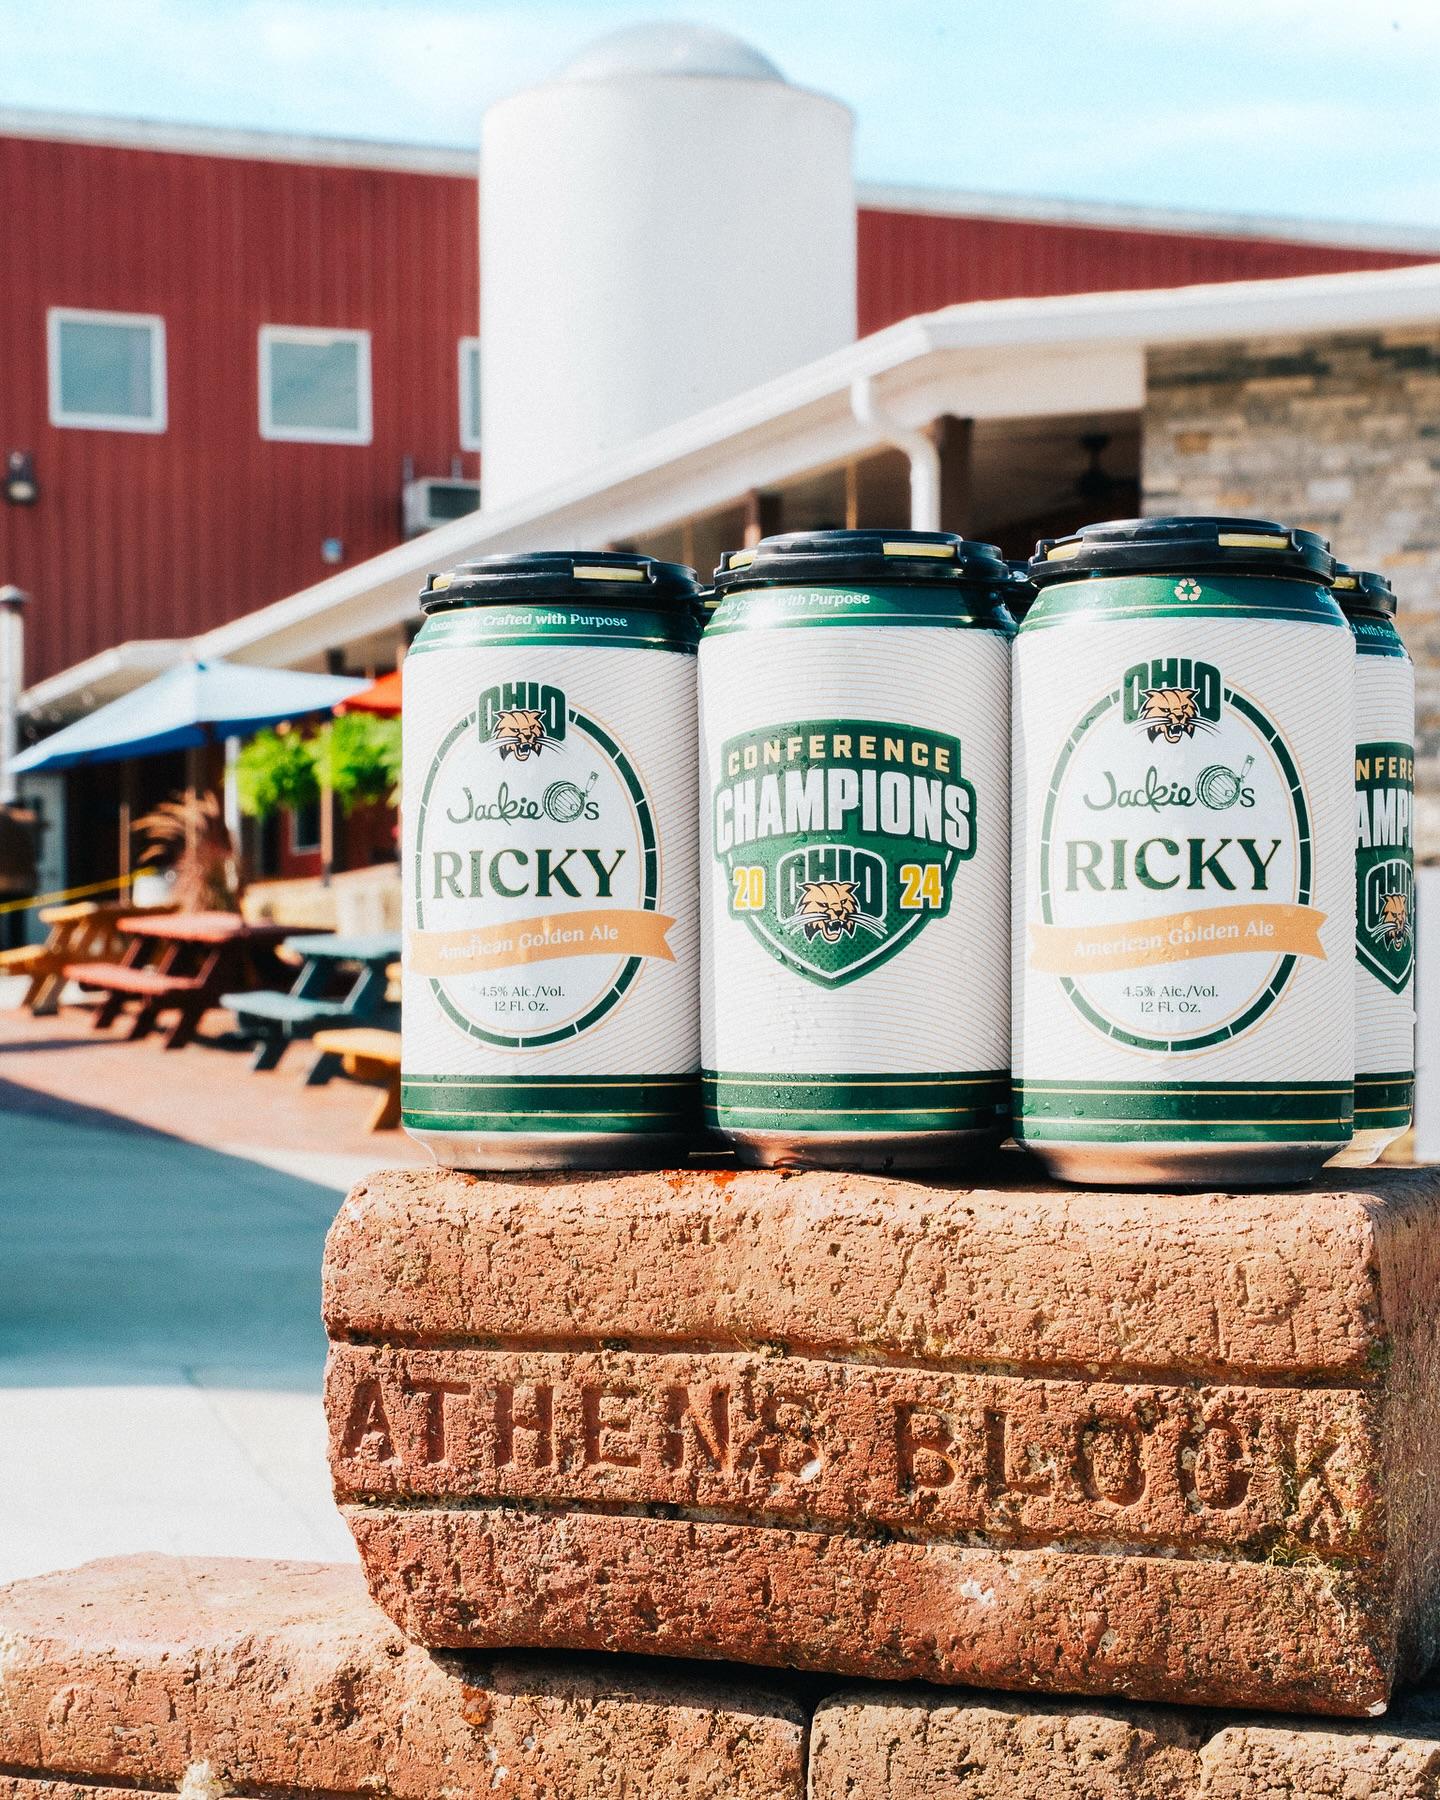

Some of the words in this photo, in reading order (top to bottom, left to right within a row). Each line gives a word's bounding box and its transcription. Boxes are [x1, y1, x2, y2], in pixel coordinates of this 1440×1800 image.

[483, 613, 532, 626] Crafted
[535, 613, 567, 625] with
[570, 613, 628, 628] Purpose
[809, 593, 871, 607] Purpose
[478, 681, 566, 743] OHIO
[1123, 658, 1221, 724] OHIO
[728, 735, 950, 777] CONFERENCE
[715, 768, 970, 852] CHAMPIONS
[432, 849, 627, 898] RICKY
[777, 845, 887, 923] OHIO
[1065, 838, 1282, 892] RICKY
[732, 865, 766, 910] 20
[900, 864, 944, 909] 24
[519, 928, 585, 950] Golden
[589, 925, 619, 941] Ale
[1074, 935, 1162, 957] American
[1168, 924, 1240, 945] Golden
[1245, 921, 1275, 937] Ale
[479, 986, 508, 998] 4.5%
[511, 985, 565, 998] Alc./Vol.
[494, 1001, 506, 1012] 12
[510, 1001, 524, 1012] Fl.
[528, 1001, 549, 1012] Oz.
[1122, 986, 1156, 998] 4.5%
[1159, 985, 1219, 998] Alc./Vol.
[1140, 1001, 1154, 1013] 12
[1158, 1001, 1174, 1013] Fl.
[1178, 1001, 1201, 1013] Oz.
[340, 1378, 823, 1484] ATHENS
[895, 1402, 1363, 1546] BLOCK
